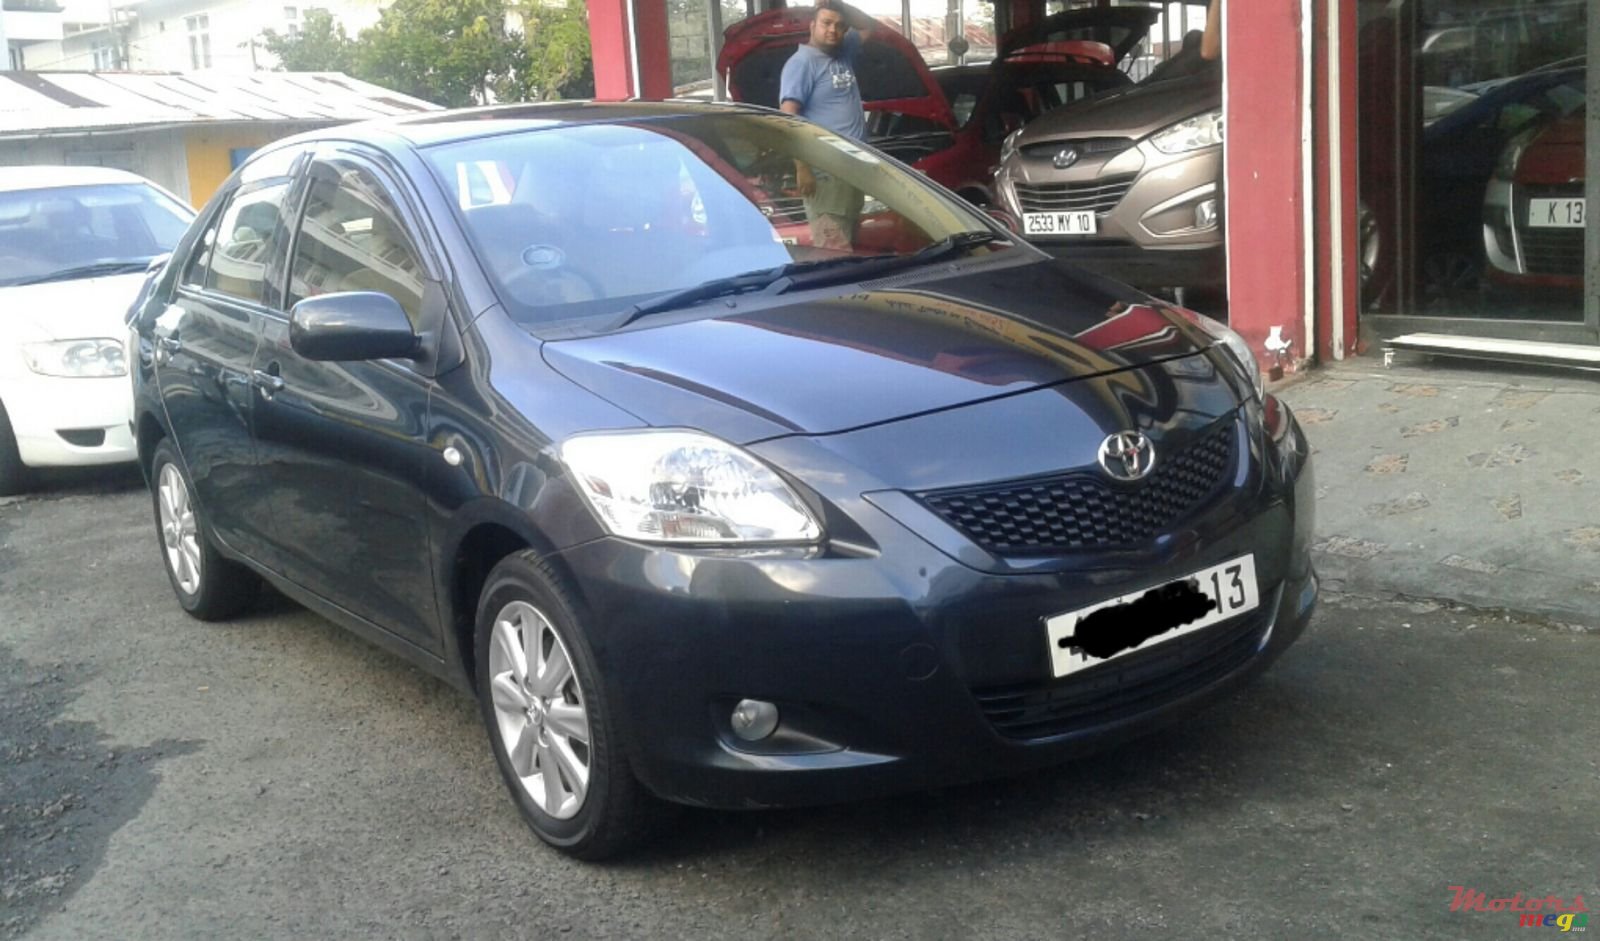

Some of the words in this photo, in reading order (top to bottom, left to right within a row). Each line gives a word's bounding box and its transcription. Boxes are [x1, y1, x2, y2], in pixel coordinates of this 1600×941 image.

[1029, 215, 1054, 232] 2533
[1057, 214, 1071, 231] MY
[1077, 214, 1089, 231] 10
[1548, 202, 1558, 224] K
[1566, 201, 1583, 224] 13
[1211, 564, 1245, 614] 13
